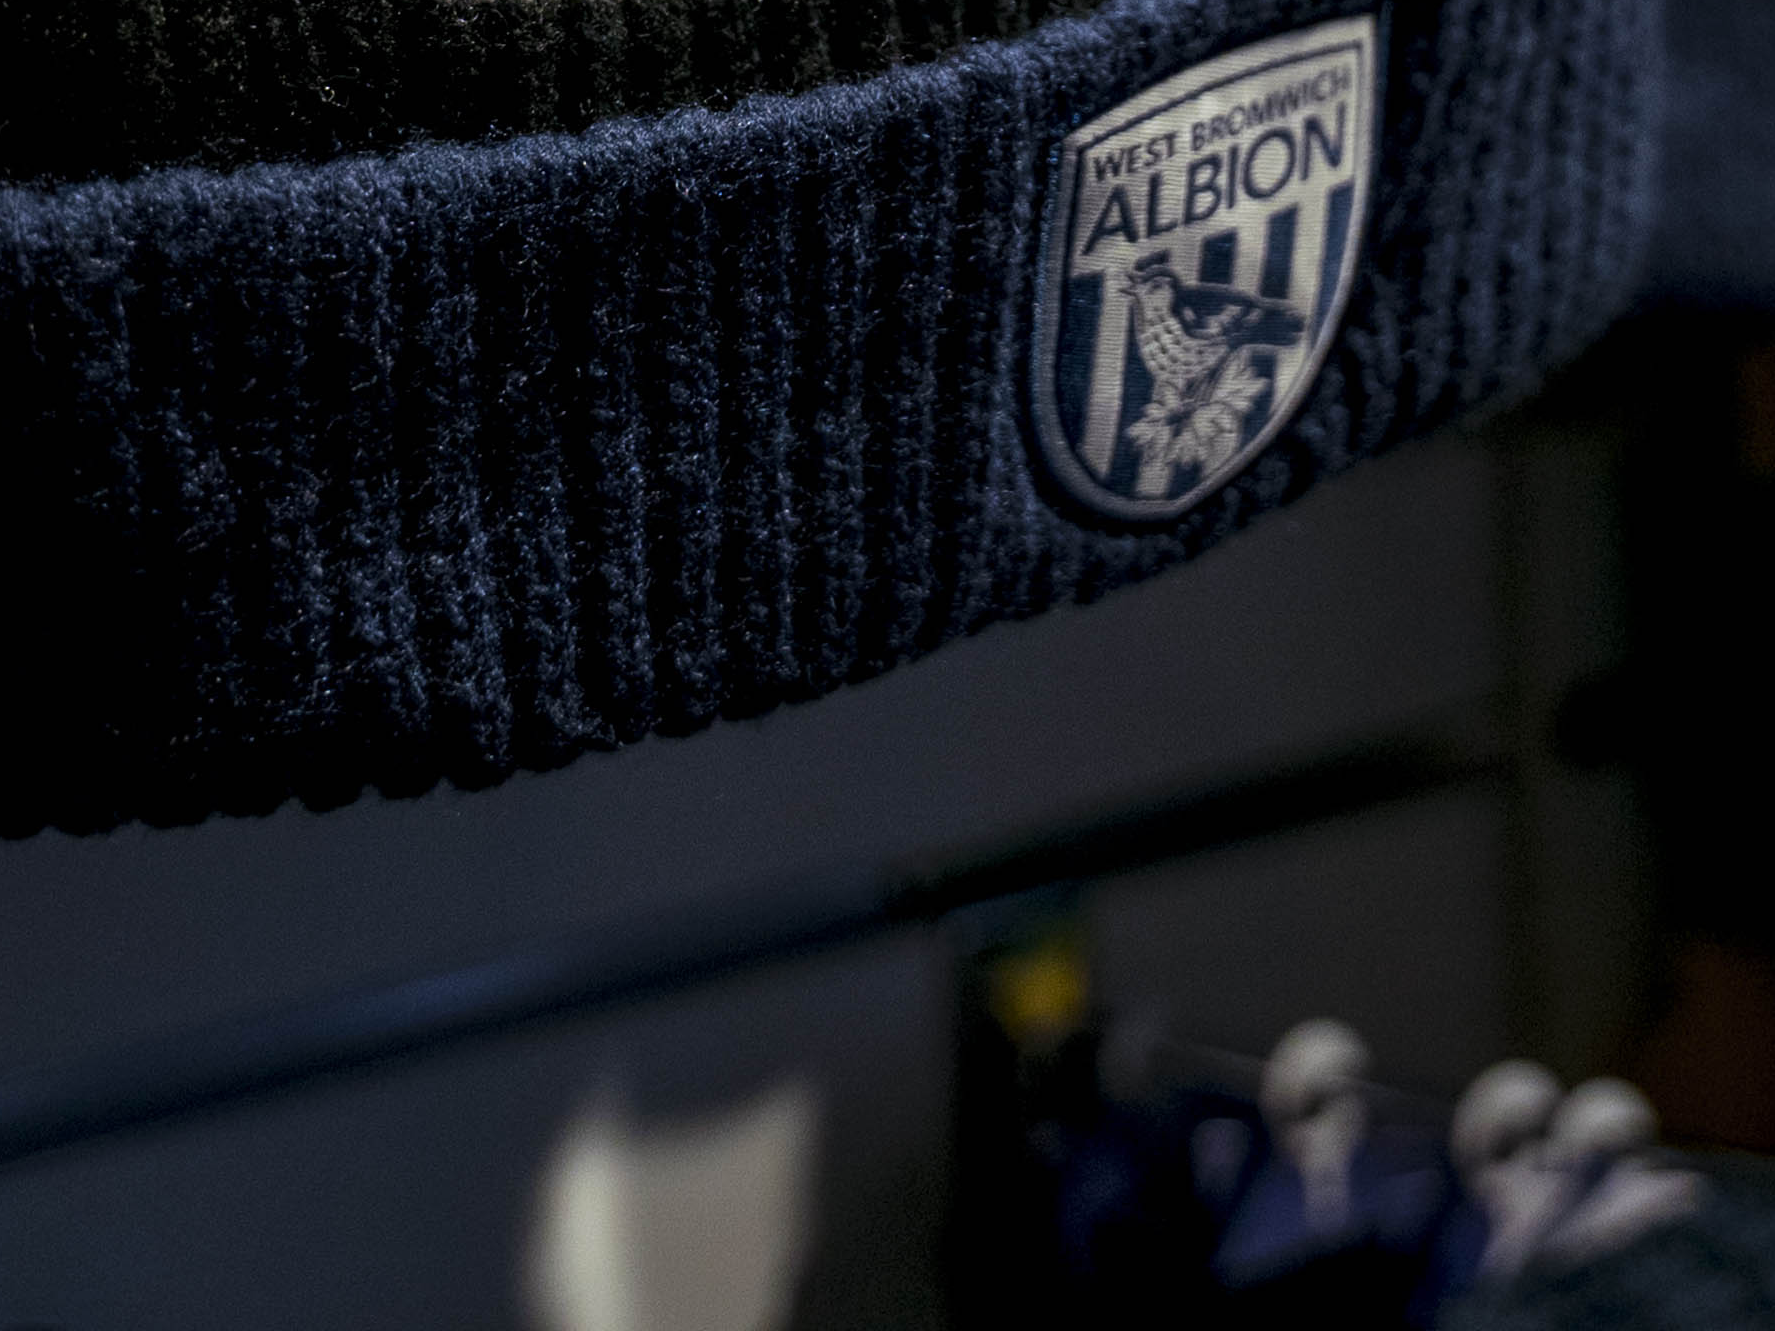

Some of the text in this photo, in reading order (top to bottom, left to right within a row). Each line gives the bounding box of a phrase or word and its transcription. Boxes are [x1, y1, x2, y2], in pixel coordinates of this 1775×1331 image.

[1079, 99, 1347, 256] ALBION
[1092, 66, 1351, 182] WEST BROMWICH
